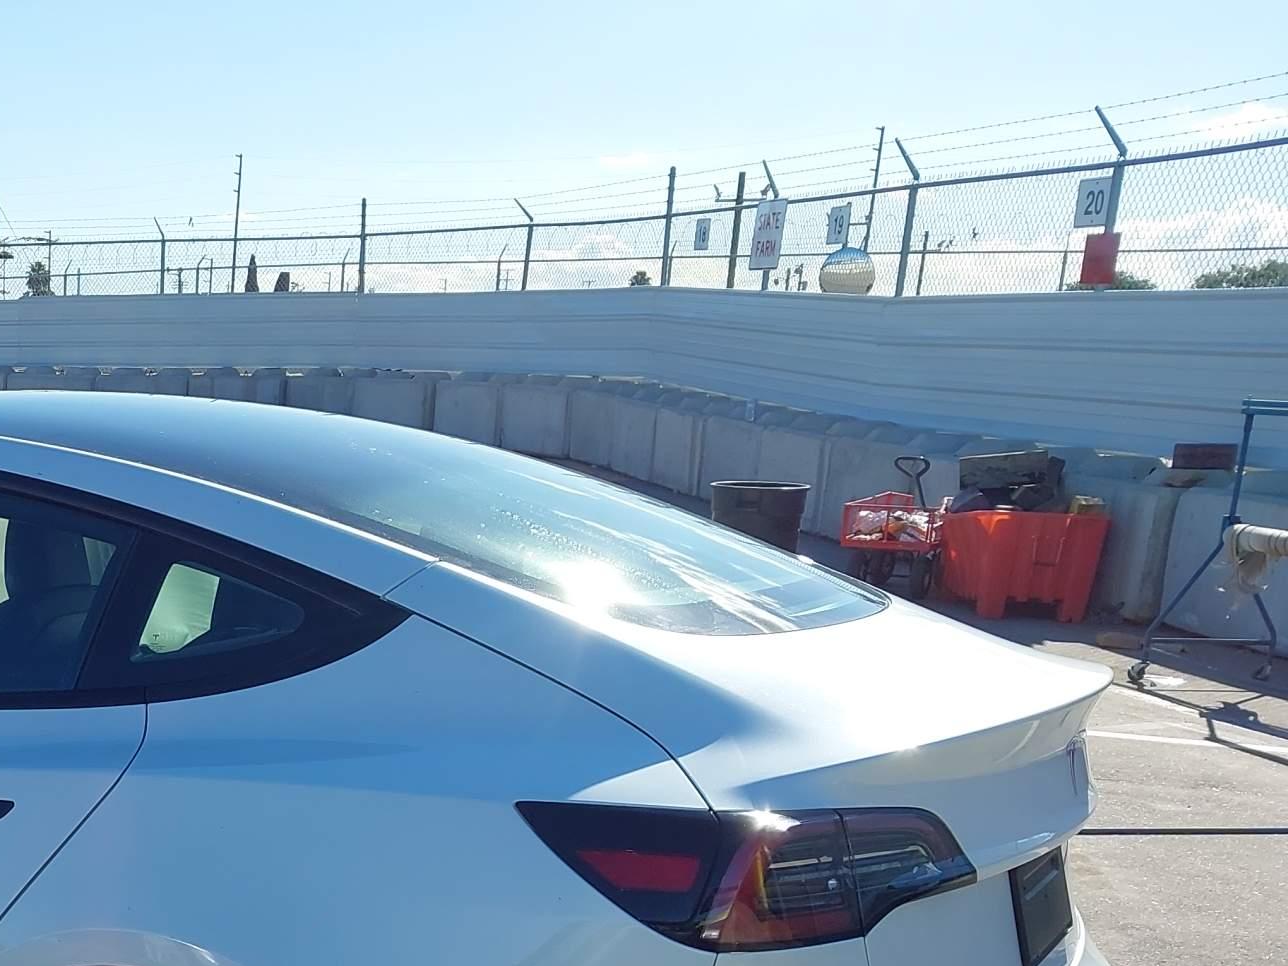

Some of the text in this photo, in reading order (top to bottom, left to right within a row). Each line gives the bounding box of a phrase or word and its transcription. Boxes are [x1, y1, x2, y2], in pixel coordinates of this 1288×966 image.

[1083, 189, 1105, 216] 20
[758, 211, 782, 231] STATE
[833, 214, 844, 235] 19
[697, 224, 707, 244] 18
[755, 240, 776, 257] FARM
